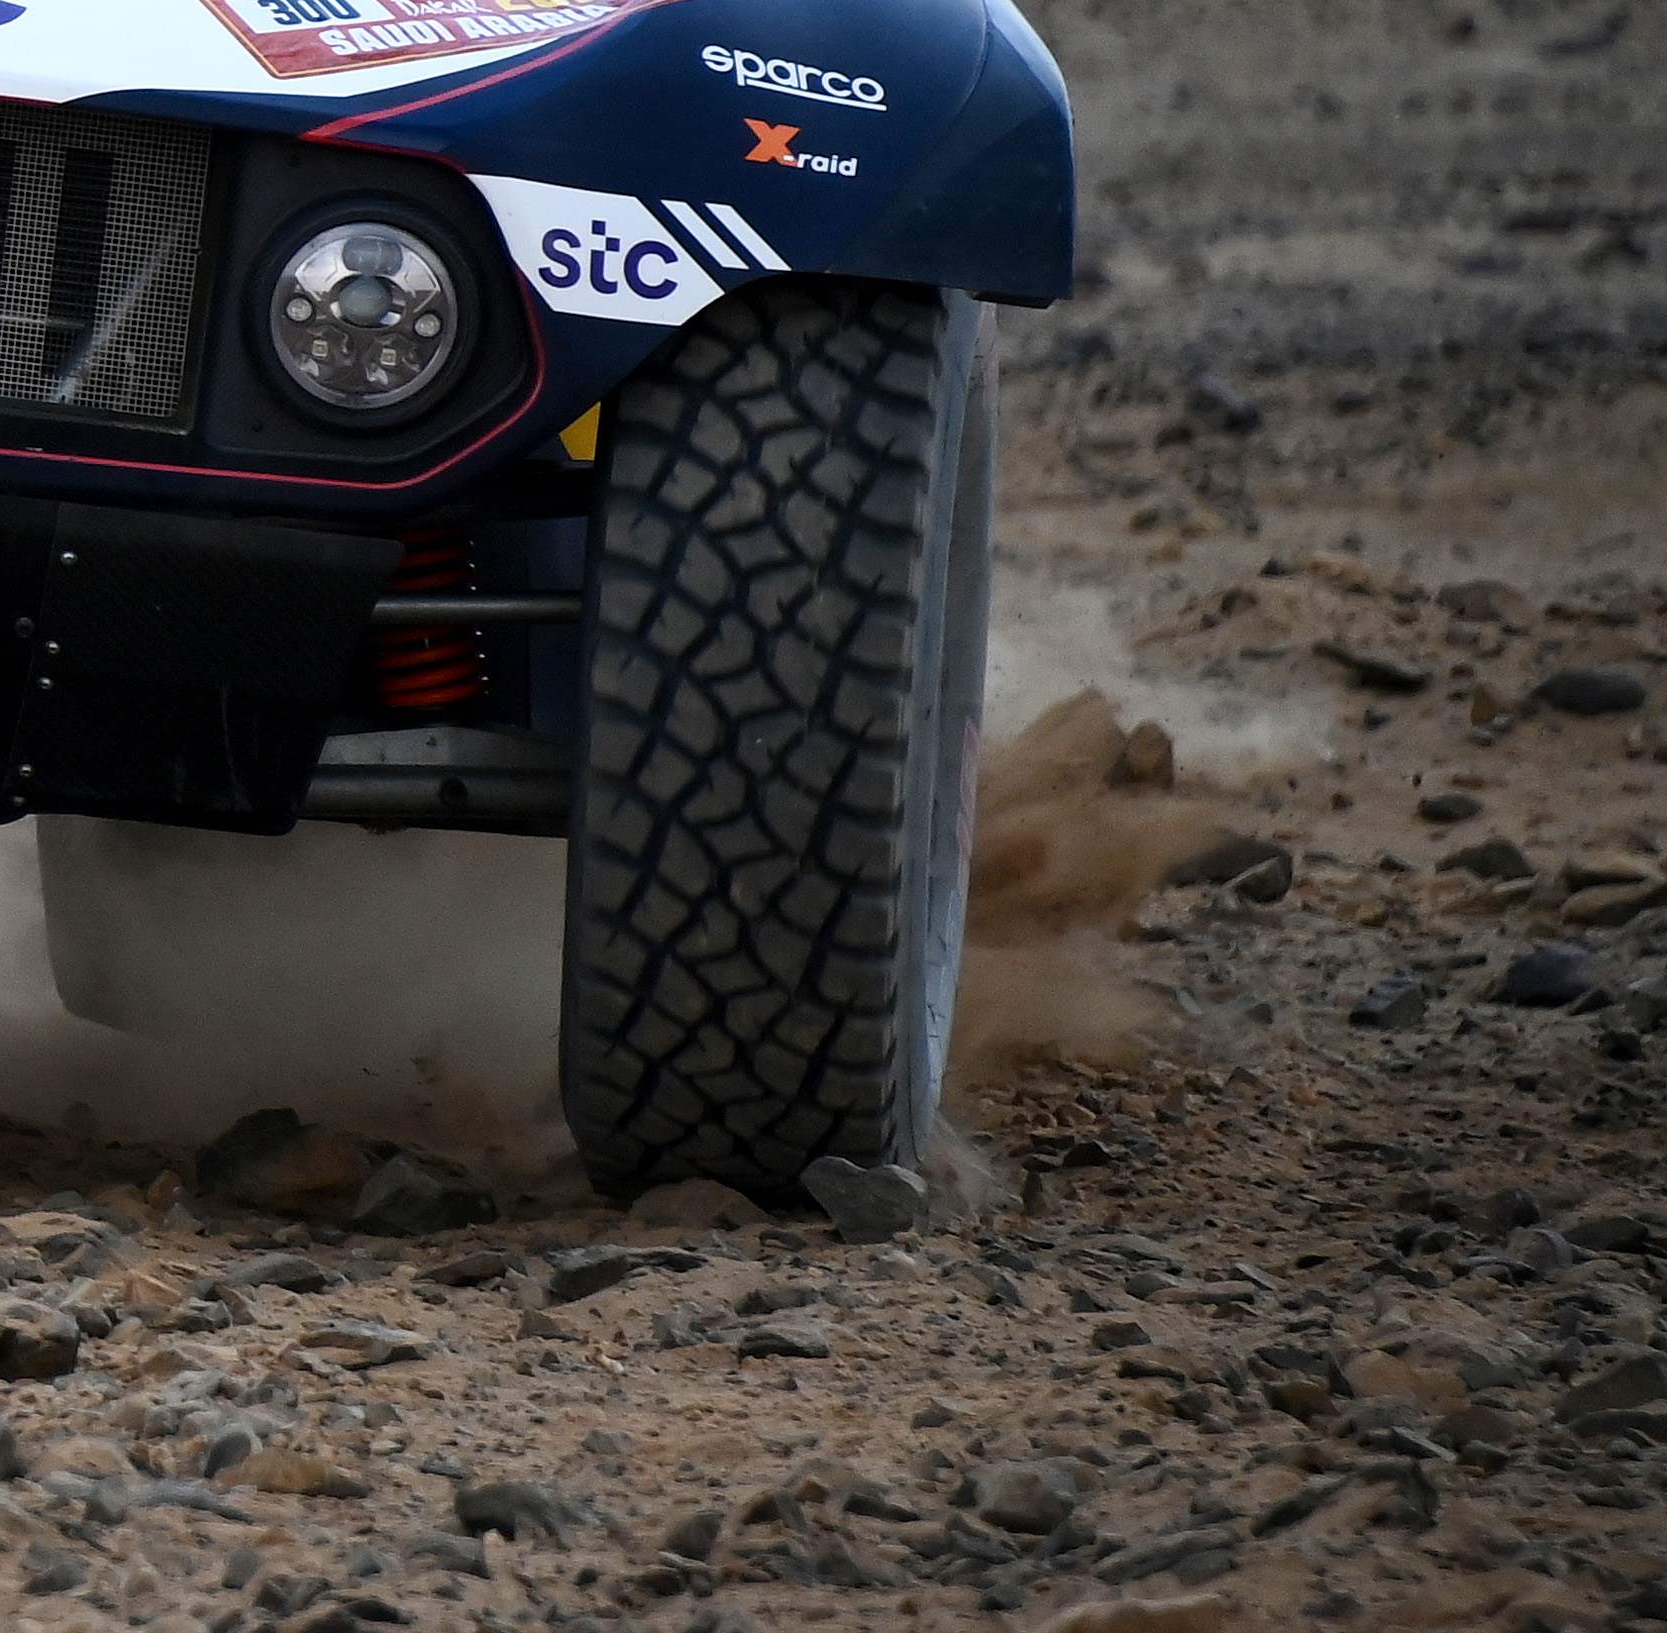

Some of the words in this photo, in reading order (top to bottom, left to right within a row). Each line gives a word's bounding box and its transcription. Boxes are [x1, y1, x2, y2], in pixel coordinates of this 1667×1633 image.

[318, 17, 457, 57] SAUDI
[458, 3, 624, 40] ARABIA
[701, 44, 885, 107] sparco
[743, 118, 858, 177] X-raid
[540, 220, 680, 300] stc
